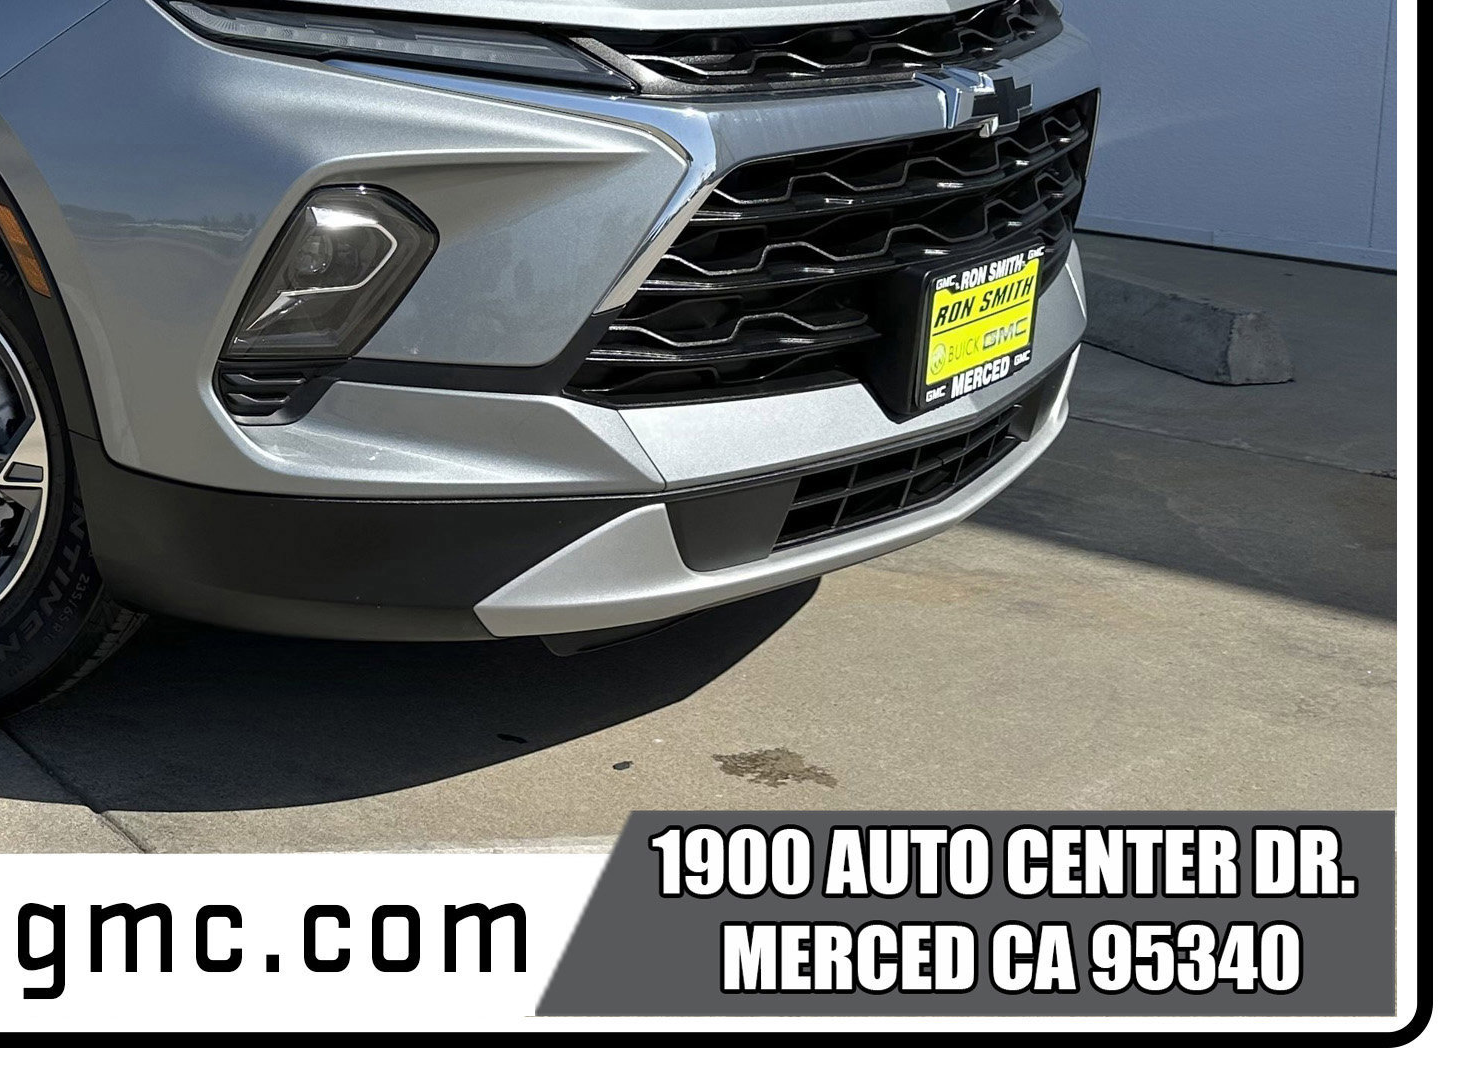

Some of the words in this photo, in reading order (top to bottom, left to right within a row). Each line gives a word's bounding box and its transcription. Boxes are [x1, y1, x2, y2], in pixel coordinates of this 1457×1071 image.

[960, 264, 987, 291] RON
[988, 253, 1024, 283] SMITH
[933, 295, 976, 329] RON
[979, 275, 1035, 313] SMITH
[947, 335, 981, 363] BUICK
[982, 316, 1029, 352] GMC
[950, 355, 1011, 399] MERCED
